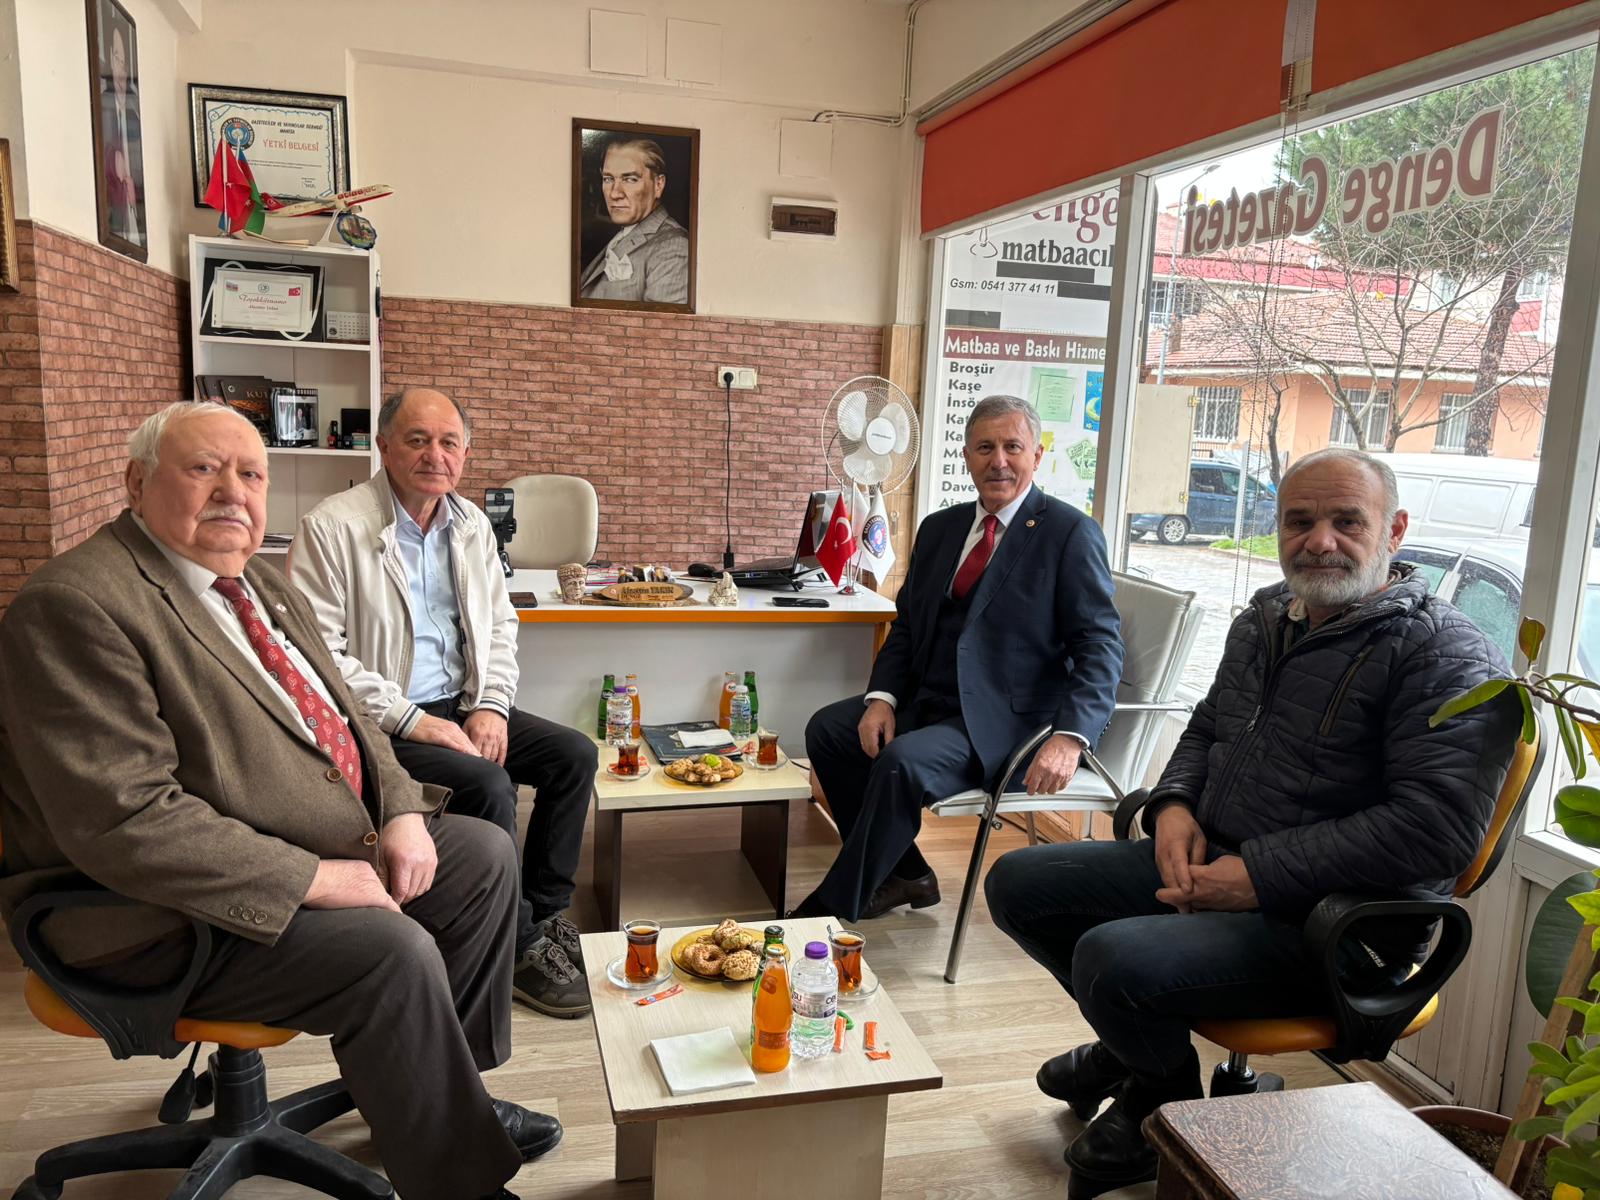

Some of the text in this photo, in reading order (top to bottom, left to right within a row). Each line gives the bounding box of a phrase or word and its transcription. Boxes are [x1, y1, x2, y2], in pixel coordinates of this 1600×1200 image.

[263, 138, 319, 152] YETKİ BELGESİ
[950, 278, 1055, 294] Gsm: 0541 377 41 11
[945, 335, 1000, 355] Matbaa
[1004, 343, 1020, 356] ve
[1025, 339, 1060, 358] Baskı
[950, 361, 995, 377] Broşür
[948, 378, 983, 394] Kaşe
[946, 393, 978, 408] İnsö
[943, 462, 972, 476] El İ
[941, 480, 976, 493] Dave
